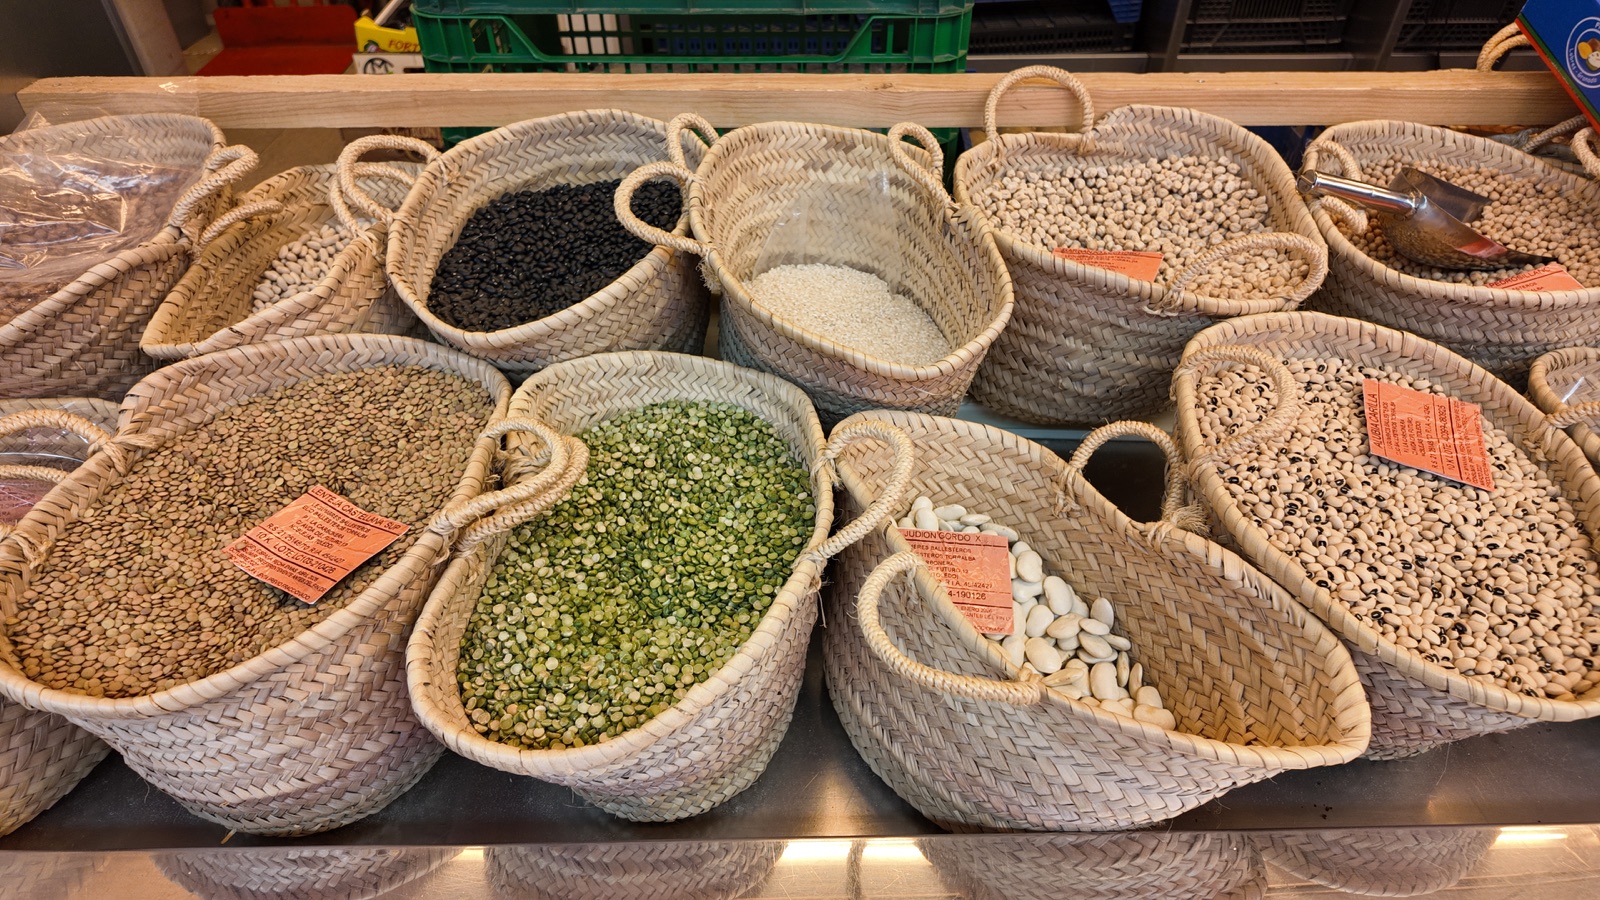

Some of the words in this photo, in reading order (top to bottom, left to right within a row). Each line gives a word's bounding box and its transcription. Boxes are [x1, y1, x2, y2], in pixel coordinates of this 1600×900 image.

[1367, 392, 1378, 422] CARILLA
[1370, 422, 1382, 447] ALUBIA
[311, 487, 343, 506] LENTEJA
[340, 504, 384, 524] CASTELLANA
[384, 522, 400, 530] SUP
[301, 523, 315, 531] AVDA
[904, 530, 937, 540] JUDION
[938, 531, 971, 542] GORDO
[255, 531, 266, 539] 10
[273, 543, 294, 556] LOTE
[931, 545, 972, 553] BALLESTEROS
[947, 590, 987, 600] 4-190126
